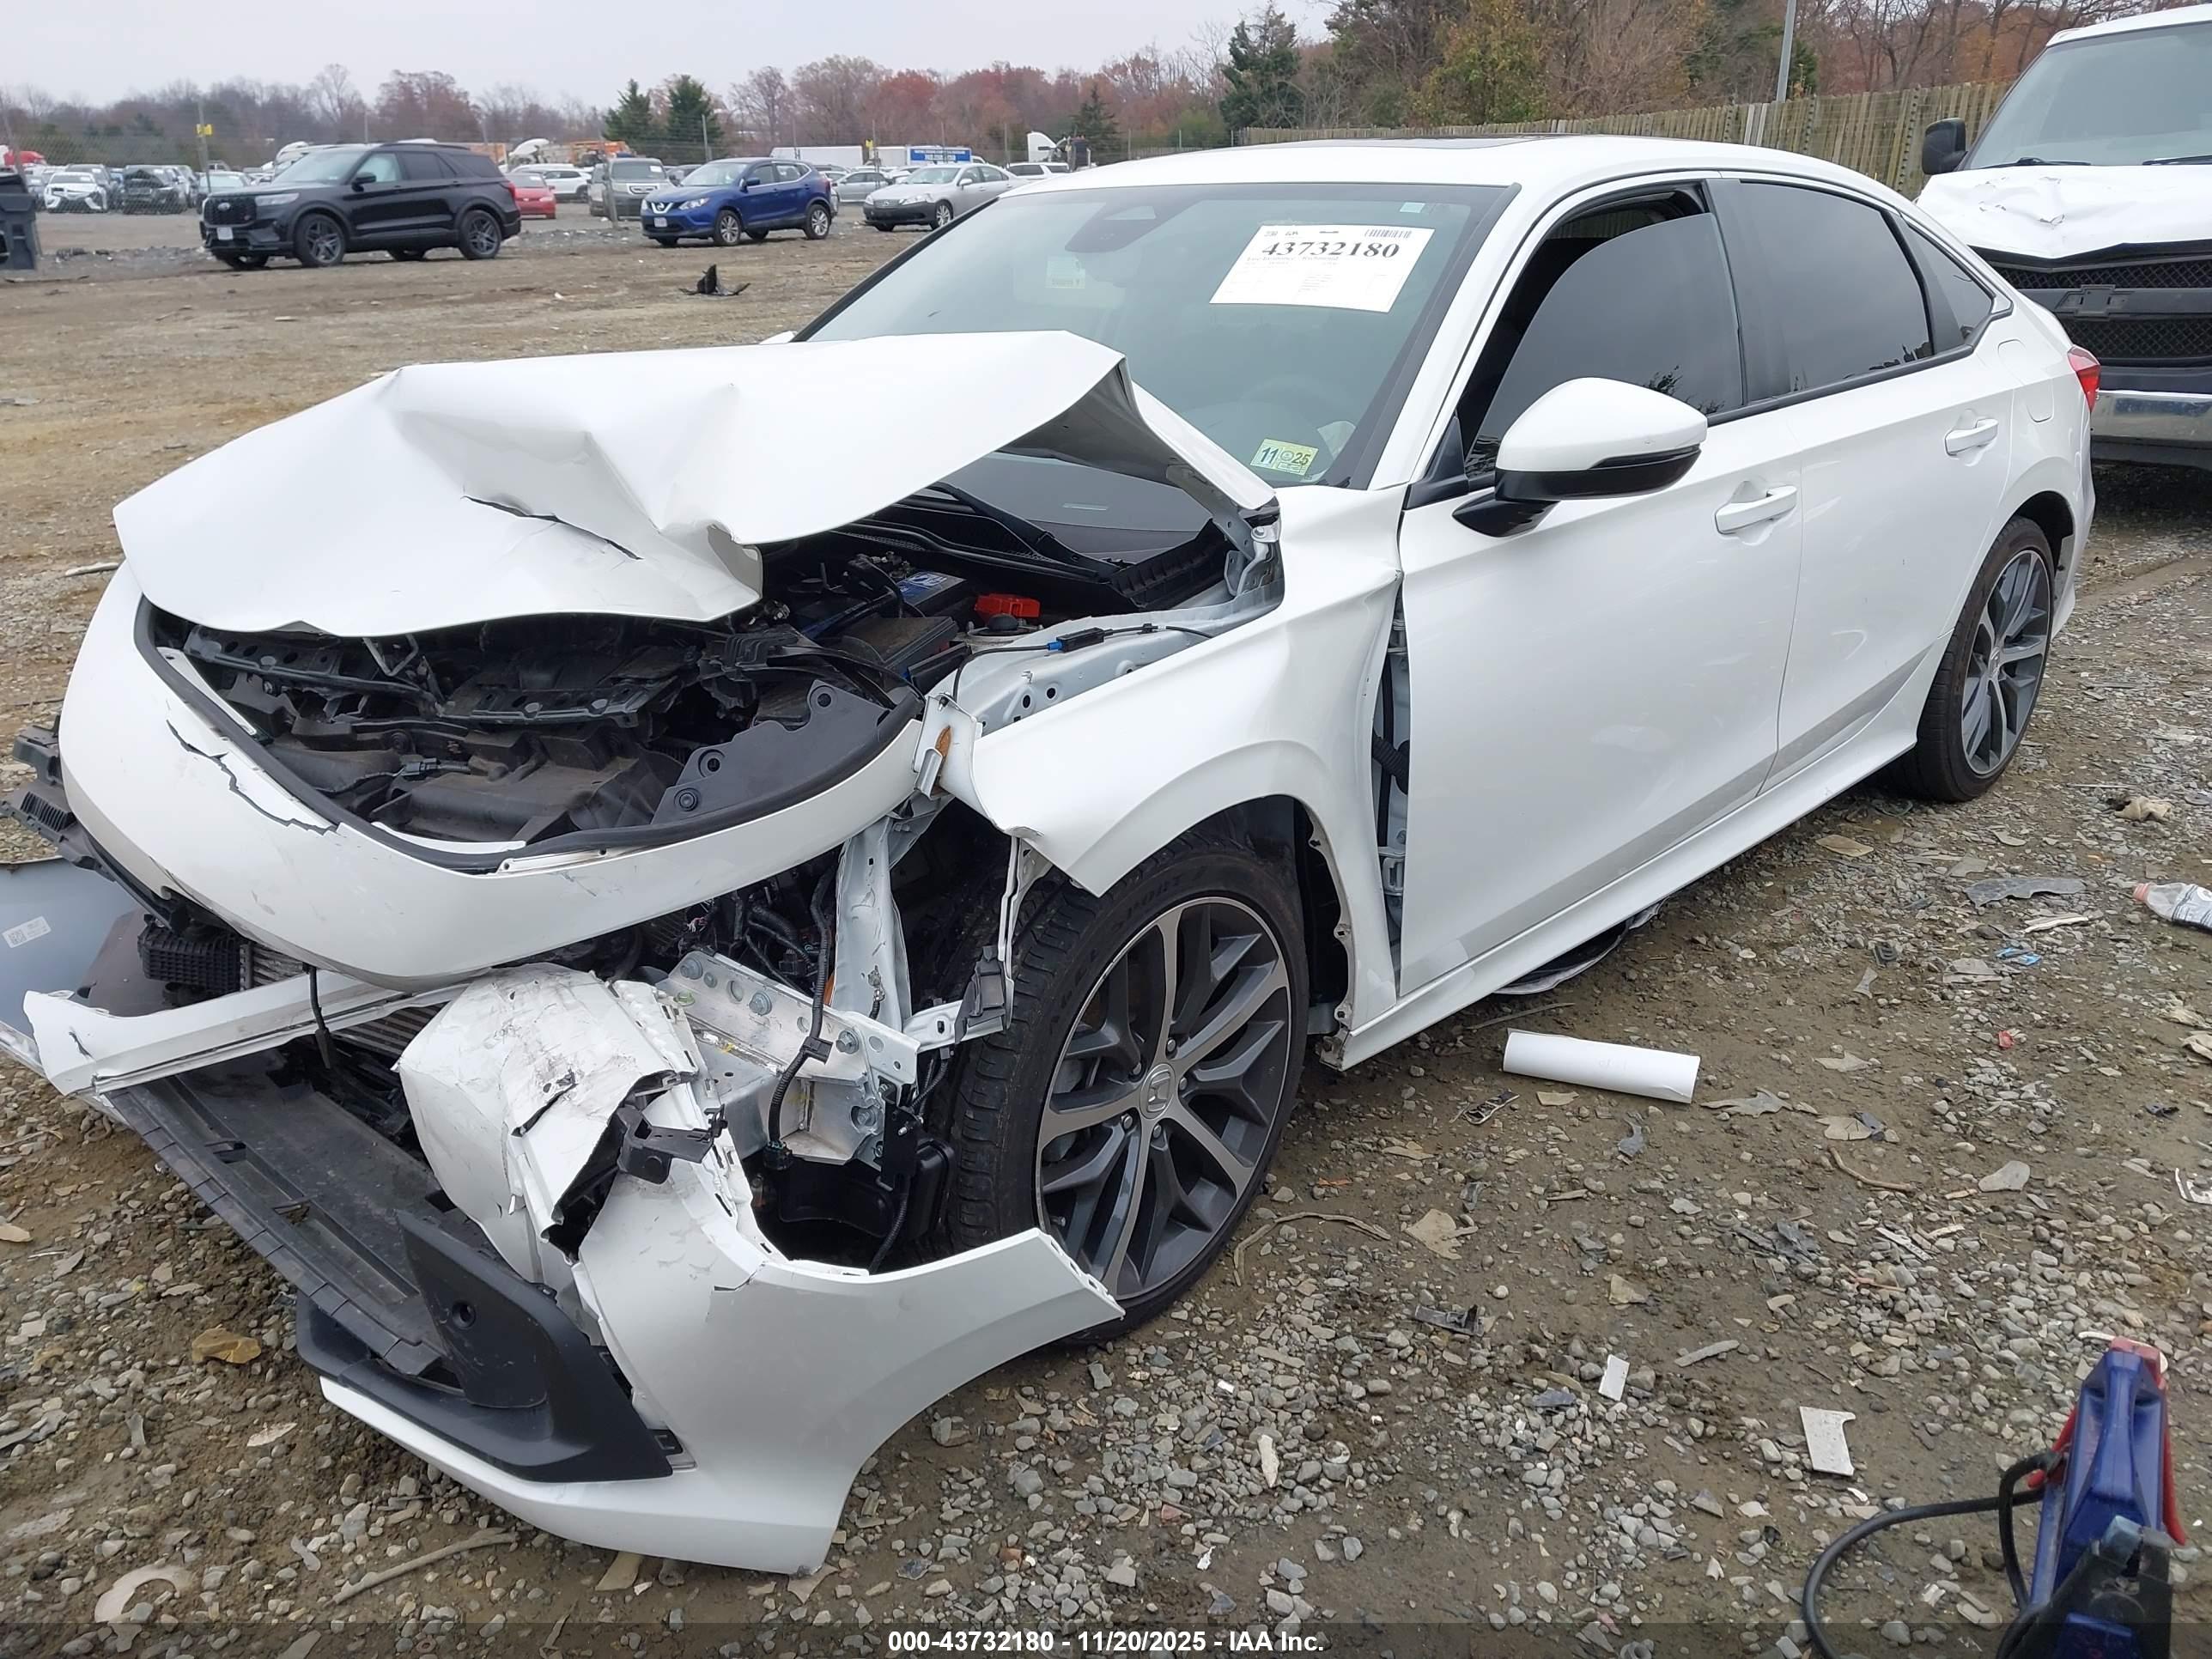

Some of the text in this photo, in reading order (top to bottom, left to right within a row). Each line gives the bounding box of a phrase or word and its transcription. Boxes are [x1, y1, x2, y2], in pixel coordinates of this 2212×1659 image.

[1261, 241, 1401, 258] 43732180
[1260, 447, 1311, 466] 11 25
